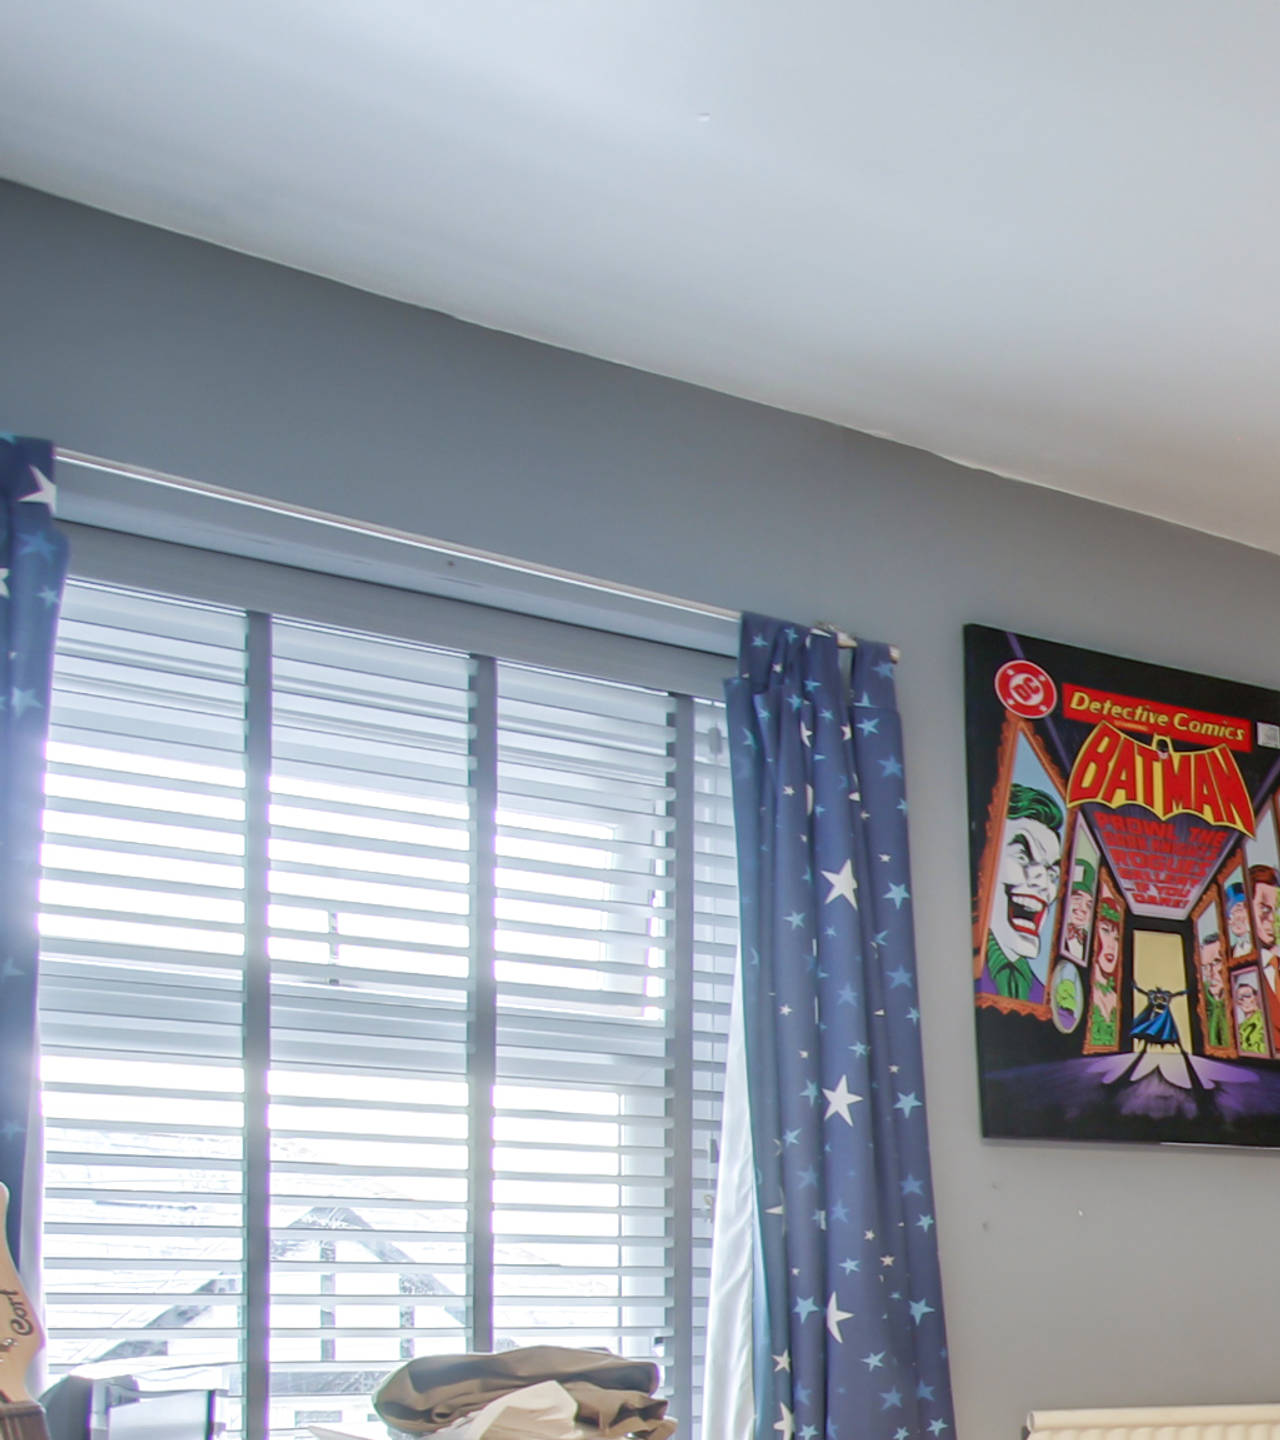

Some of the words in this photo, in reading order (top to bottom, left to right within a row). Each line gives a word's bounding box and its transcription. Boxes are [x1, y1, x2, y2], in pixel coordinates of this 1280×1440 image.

[1011, 675, 1041, 702] DC
[1070, 691, 1169, 727] Detective
[1173, 713, 1246, 742] Comics
[1070, 722, 1254, 836] BATMAN
[1189, 827, 1230, 848] THE
